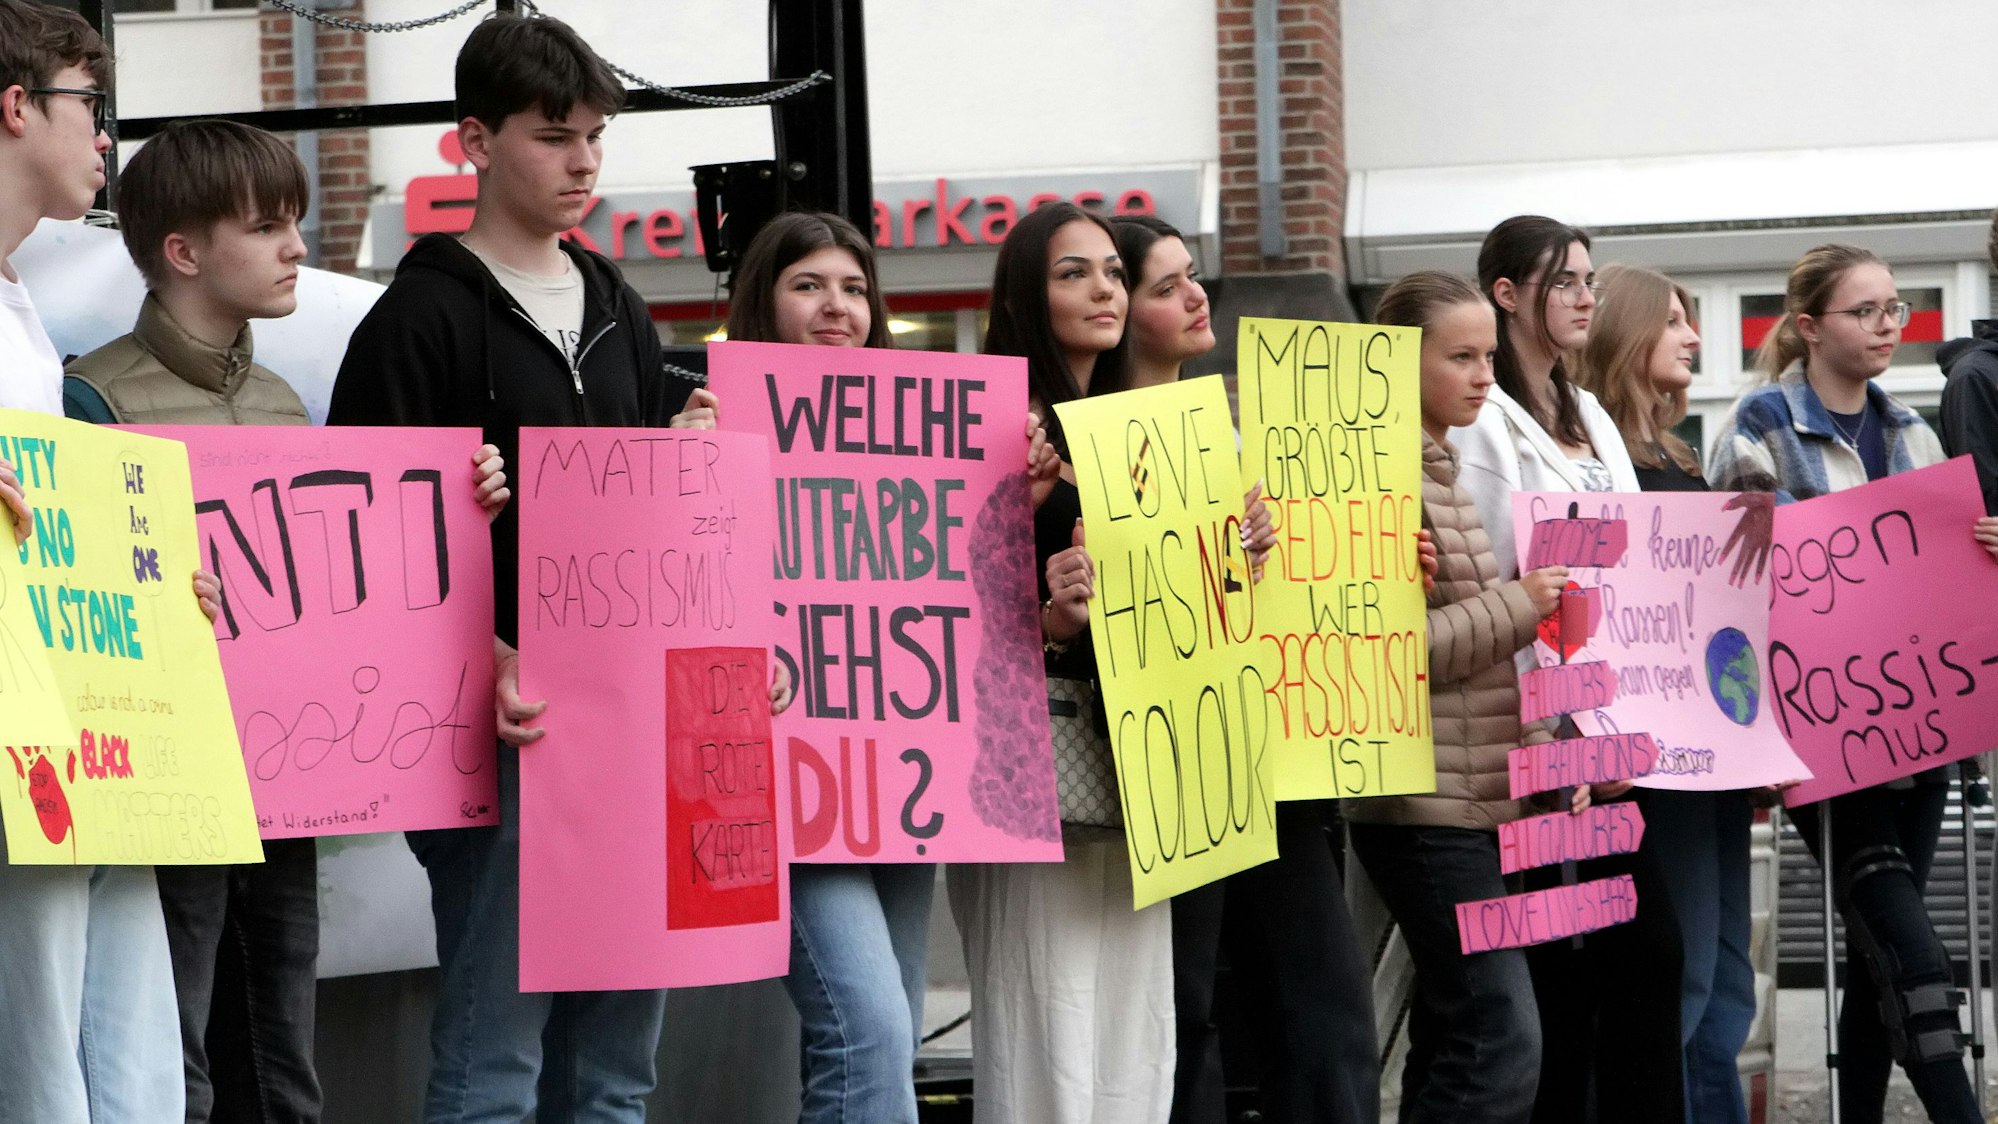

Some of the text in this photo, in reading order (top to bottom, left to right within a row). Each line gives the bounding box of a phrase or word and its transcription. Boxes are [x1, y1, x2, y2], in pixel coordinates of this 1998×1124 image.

[765, 373, 986, 462] WELCHE
[0, 435, 56, 490] UTY
[122, 462, 144, 494] WE
[534, 439, 723, 500] MATER
[1090, 406, 1220, 522] LOVE
[33, 507, 75, 568] NO
[195, 469, 449, 641] NTI
[692, 499, 737, 550] zeigt
[773, 476, 967, 582] UTFARBE
[1260, 494, 1418, 583] RED FLAG
[1650, 505, 1720, 576] keine
[1769, 509, 1919, 614] egen
[537, 549, 737, 631] RASSISMUS
[1100, 514, 1254, 678] HAS NO
[1308, 581, 1383, 636] WER
[242, 661, 482, 780] ssist
[1259, 630, 1431, 740] RASSISTISCH
[1768, 634, 1998, 739] Rassis-
[81, 728, 134, 779] BLACK
[700, 742, 766, 794] ROTE
[1118, 665, 1273, 875] COLOUR
[1329, 738, 1390, 796] IST
[94, 788, 228, 861] MATTERS
[256, 816, 274, 829] tet
[788, 736, 882, 859] DU
[690, 820, 773, 884] KARTE
